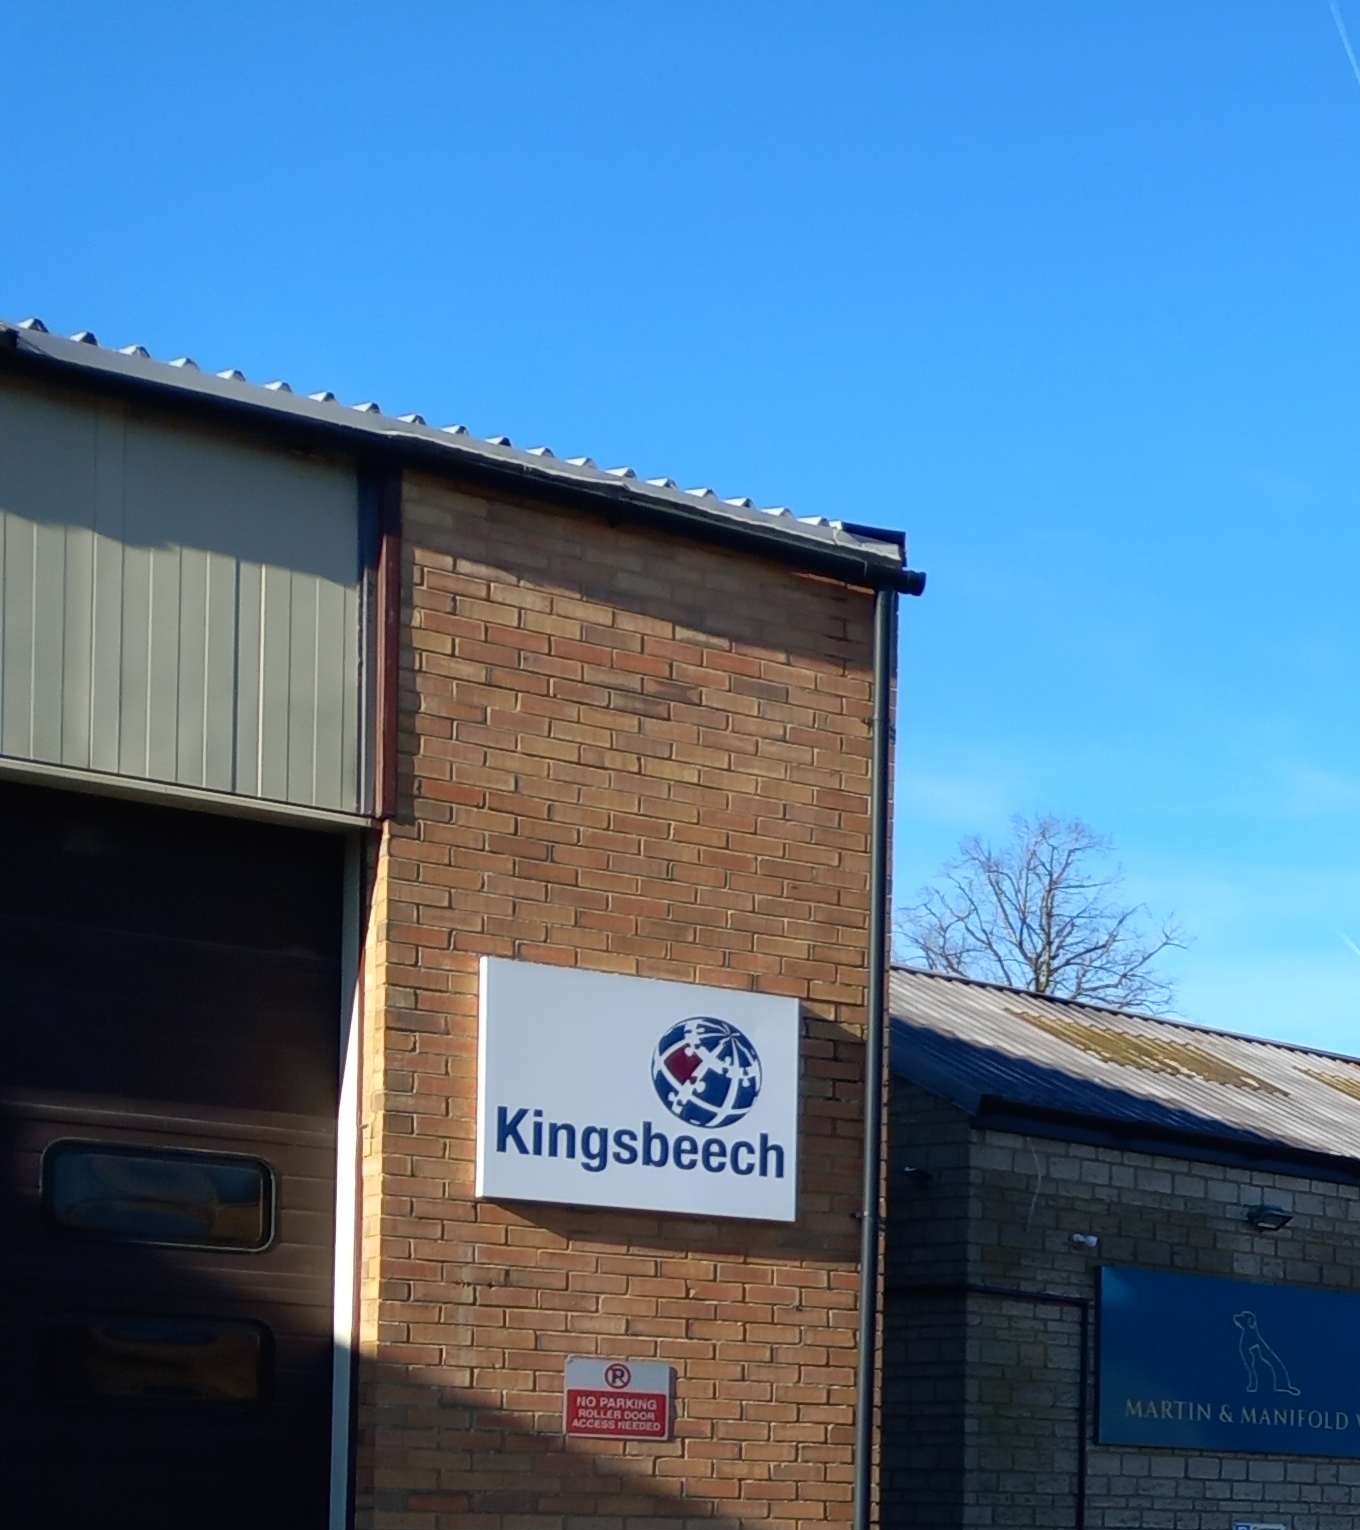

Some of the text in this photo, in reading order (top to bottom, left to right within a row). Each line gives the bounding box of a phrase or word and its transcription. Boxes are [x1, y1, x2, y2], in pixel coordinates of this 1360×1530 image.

[495, 1105, 786, 1179] Kingsbeech
[576, 1396, 657, 1410] NO PARKING
[578, 1408, 655, 1421] ROLLER DOOR
[1124, 1398, 1212, 1422] MARTIN
[1218, 1403, 1234, 1423] &
[1239, 1406, 1349, 1431] MANIFOLD
[571, 1418, 661, 1431] ACCESS NEEDED
